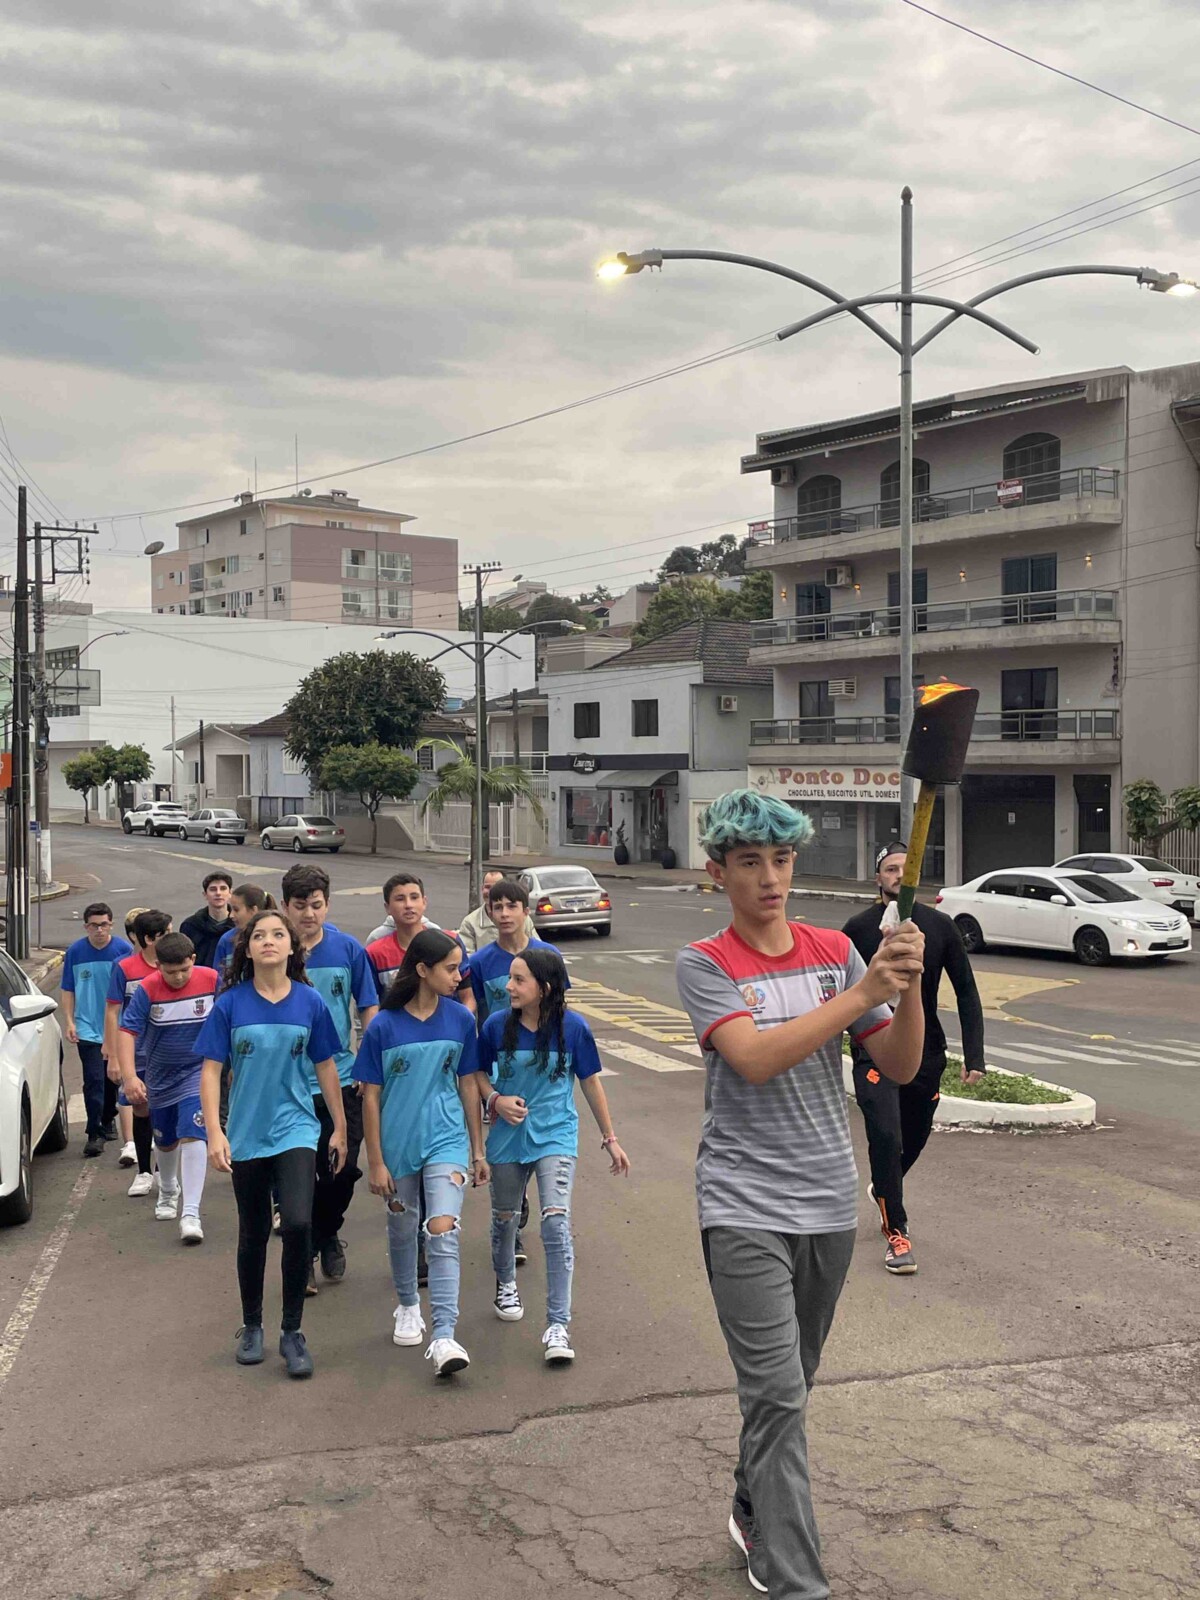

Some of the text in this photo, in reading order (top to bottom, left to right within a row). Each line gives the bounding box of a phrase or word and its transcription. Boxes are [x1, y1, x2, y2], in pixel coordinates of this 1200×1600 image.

[778, 768, 844, 784] Ponto
[788, 789, 826, 798] CHOCOLATES,
[827, 789, 857, 798] BISCOITOS
